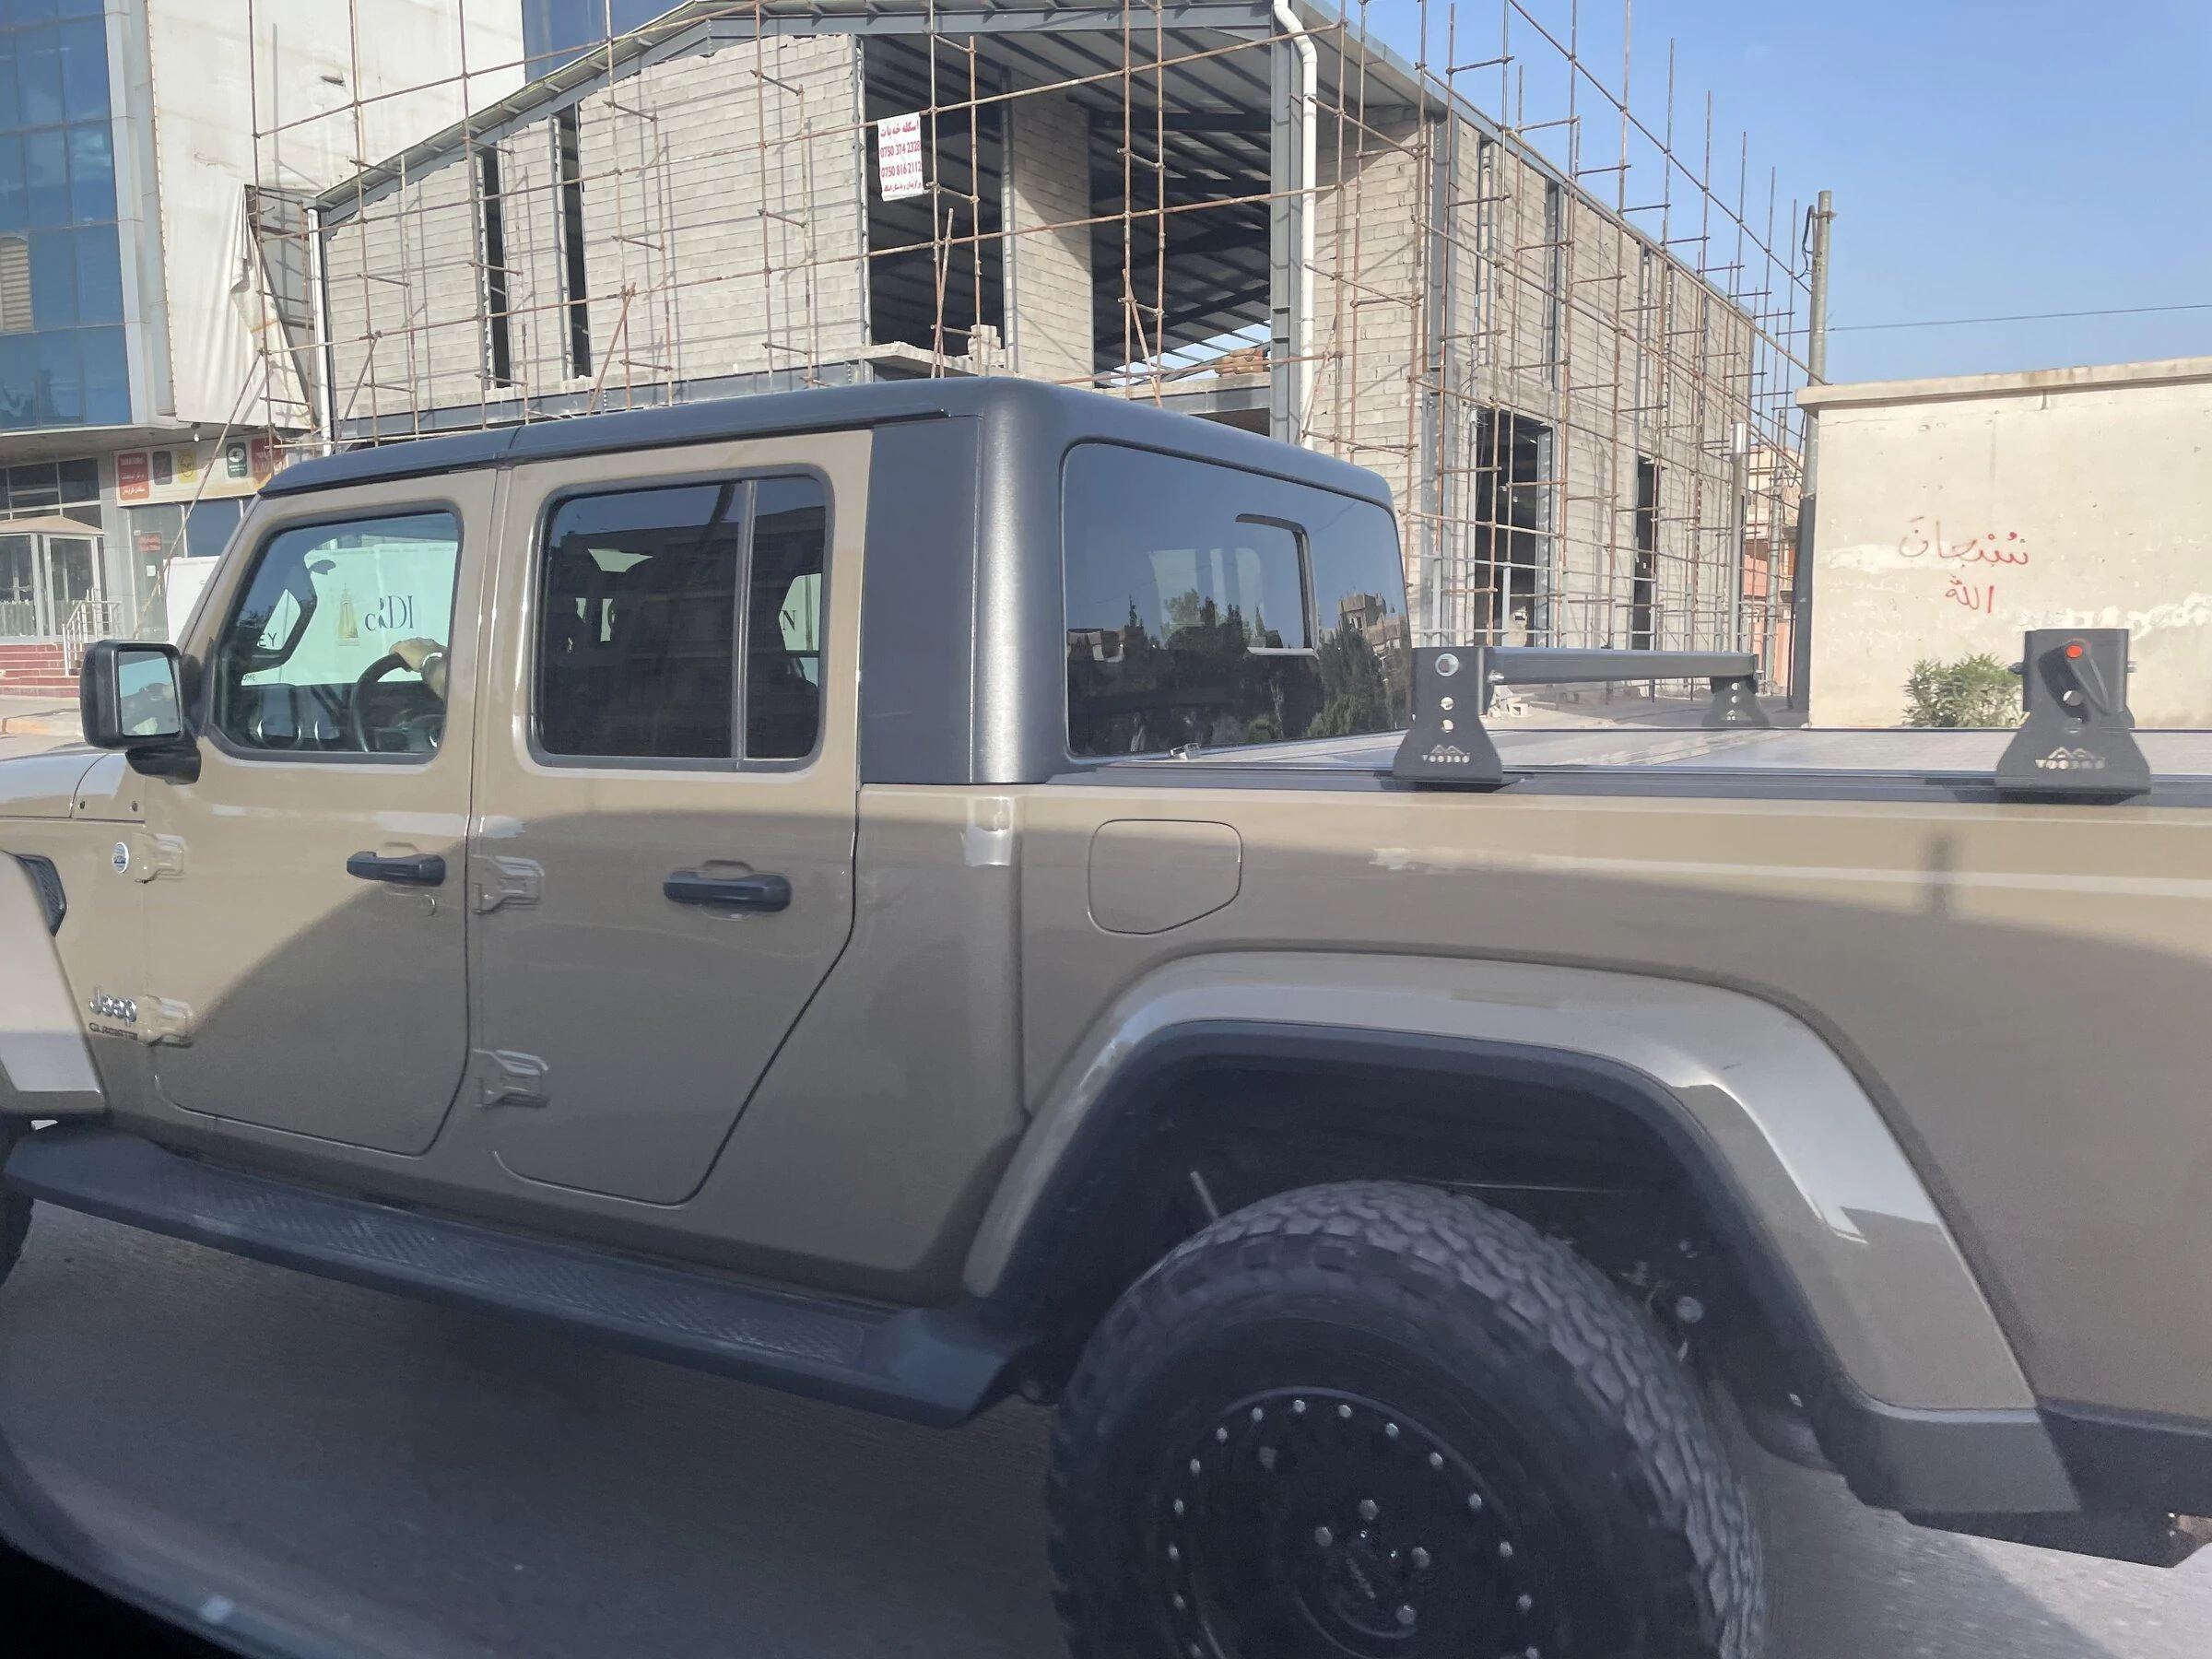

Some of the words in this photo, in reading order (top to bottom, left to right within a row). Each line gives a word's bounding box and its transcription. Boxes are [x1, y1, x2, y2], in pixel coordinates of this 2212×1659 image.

[880, 146, 894, 158] 0750
[896, 144, 906, 155] 374
[881, 166, 895, 178] 0750
[897, 164, 907, 175] 816
[908, 161, 922, 174] 2112
[88, 984, 137, 1027] Jeep
